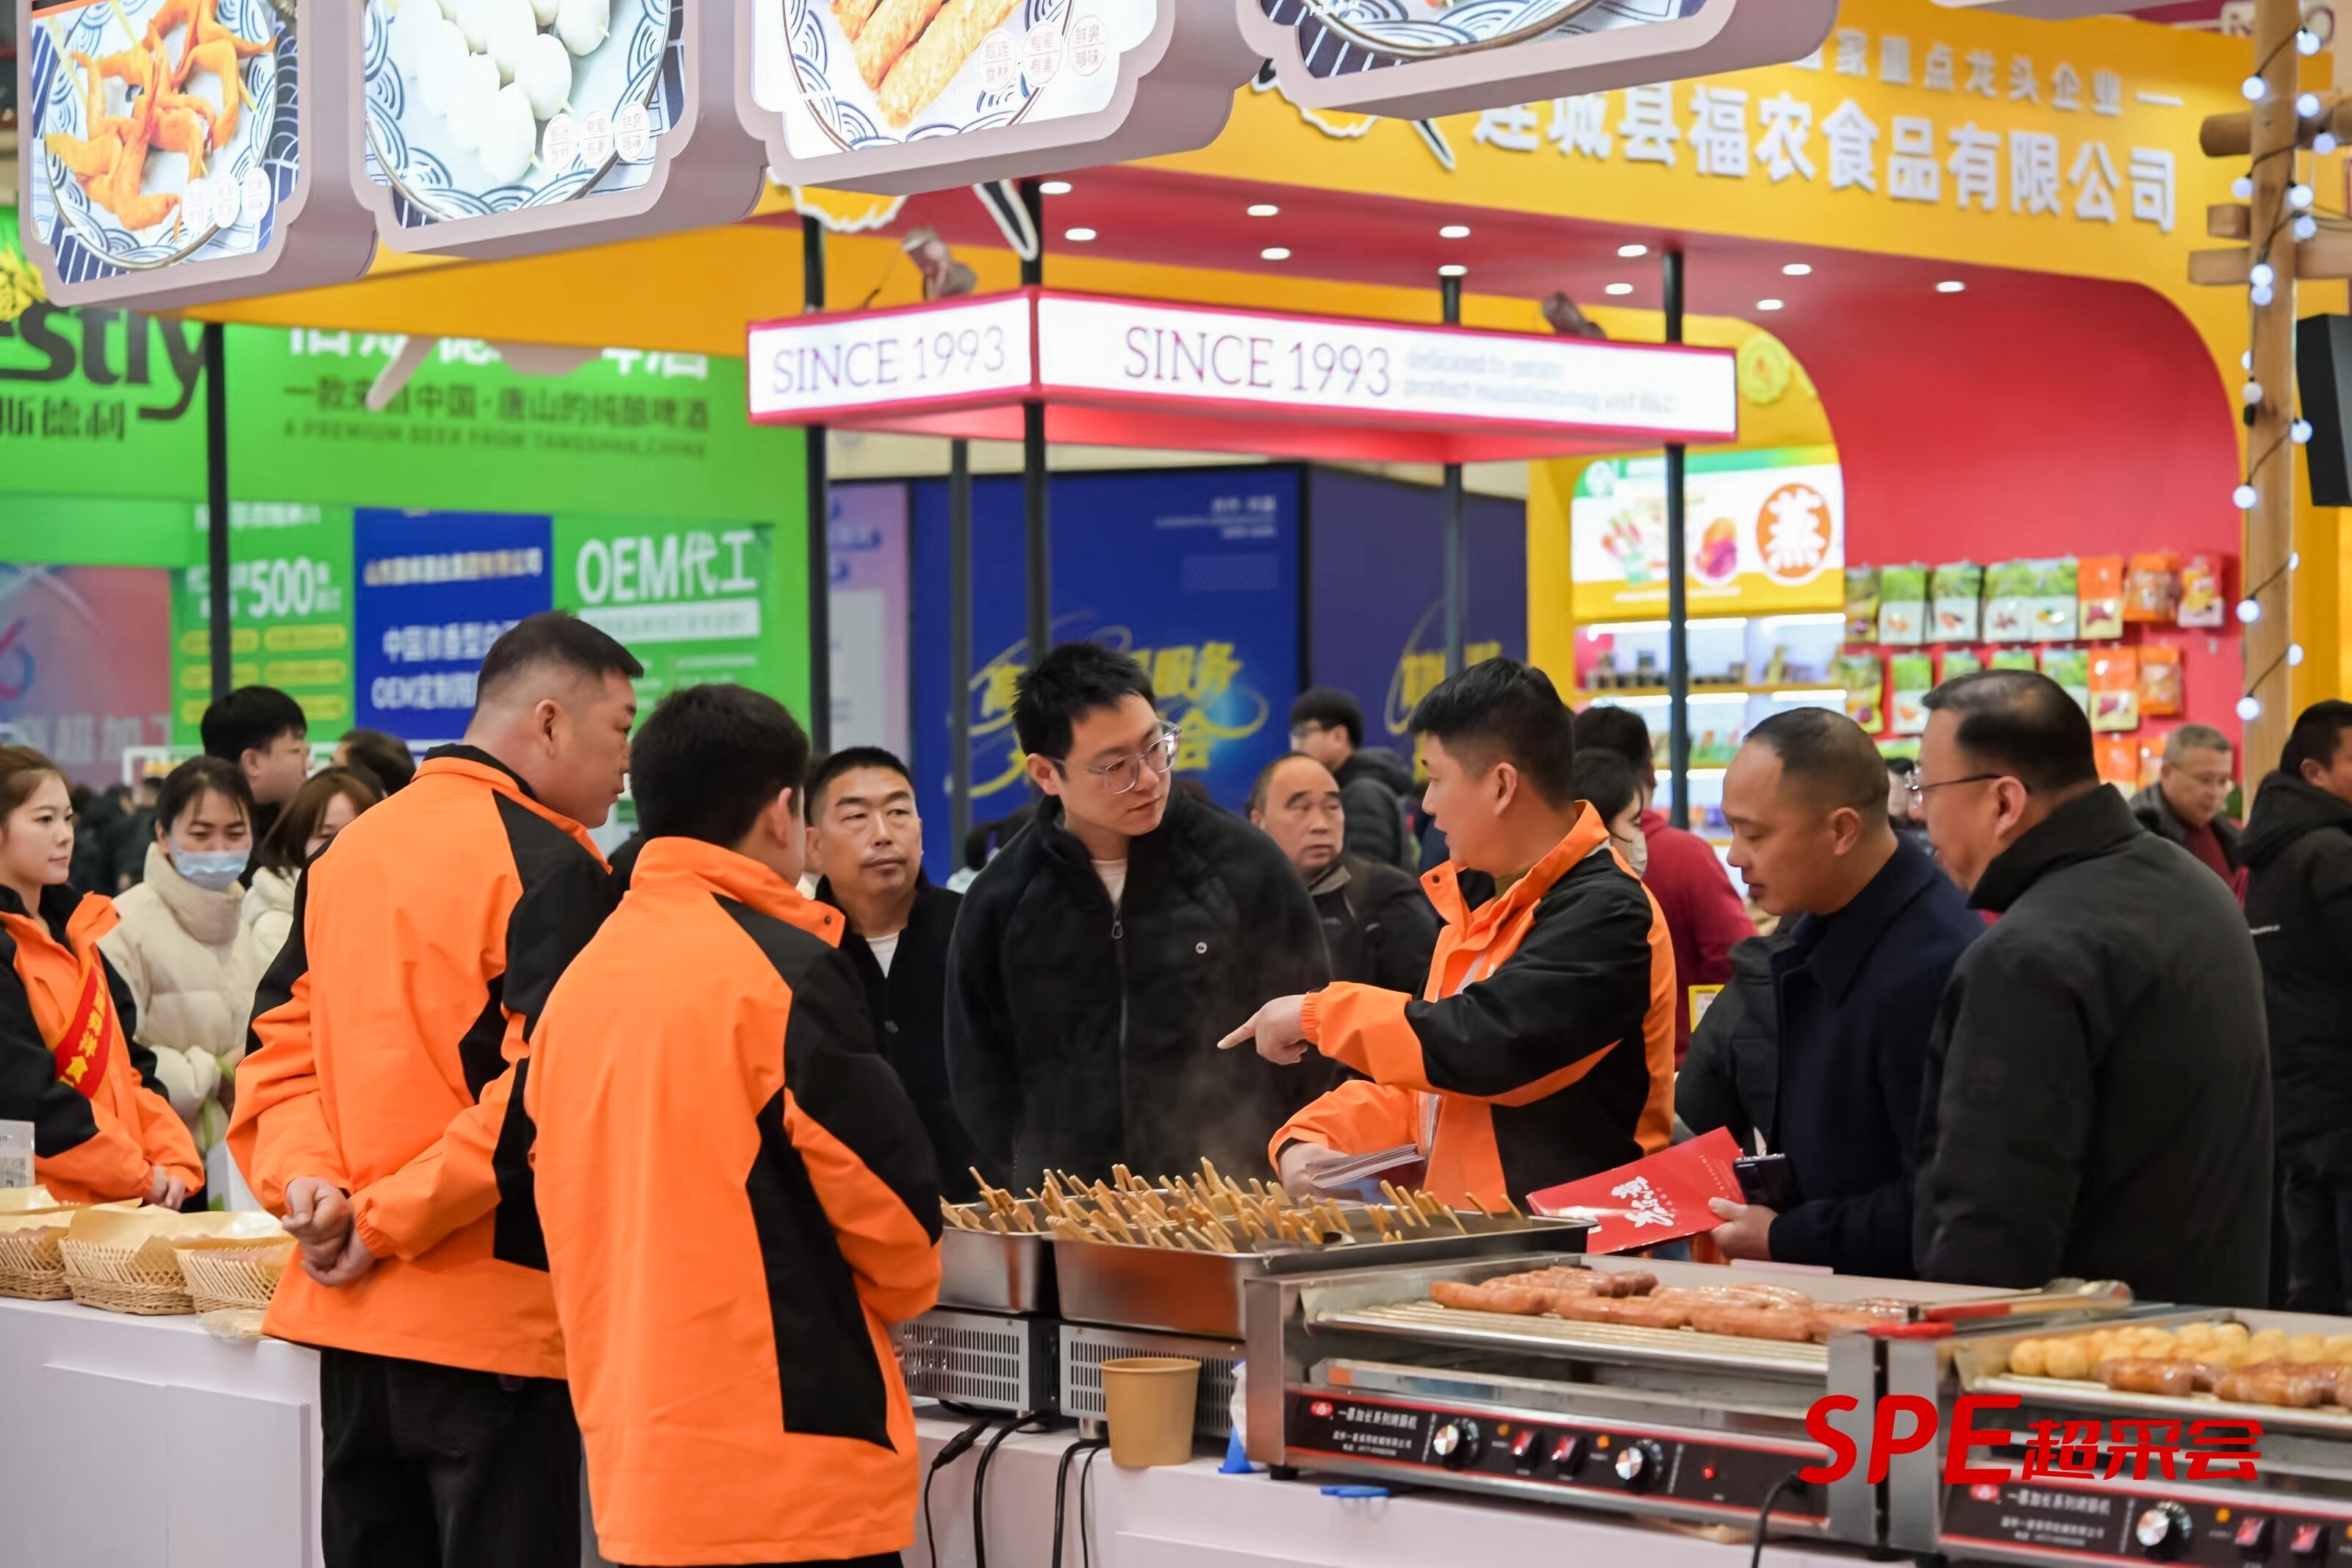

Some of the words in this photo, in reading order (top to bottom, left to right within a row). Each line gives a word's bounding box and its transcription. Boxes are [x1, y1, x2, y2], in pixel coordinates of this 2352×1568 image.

[0, 294, 207, 422] stly
[772, 339, 900, 395] SINCE
[913, 326, 1007, 383] 1993
[1125, 326, 1274, 389] SINCE
[1288, 341, 1391, 397] 1993
[248, 555, 314, 620] 500
[576, 530, 759, 605] OEM代工
